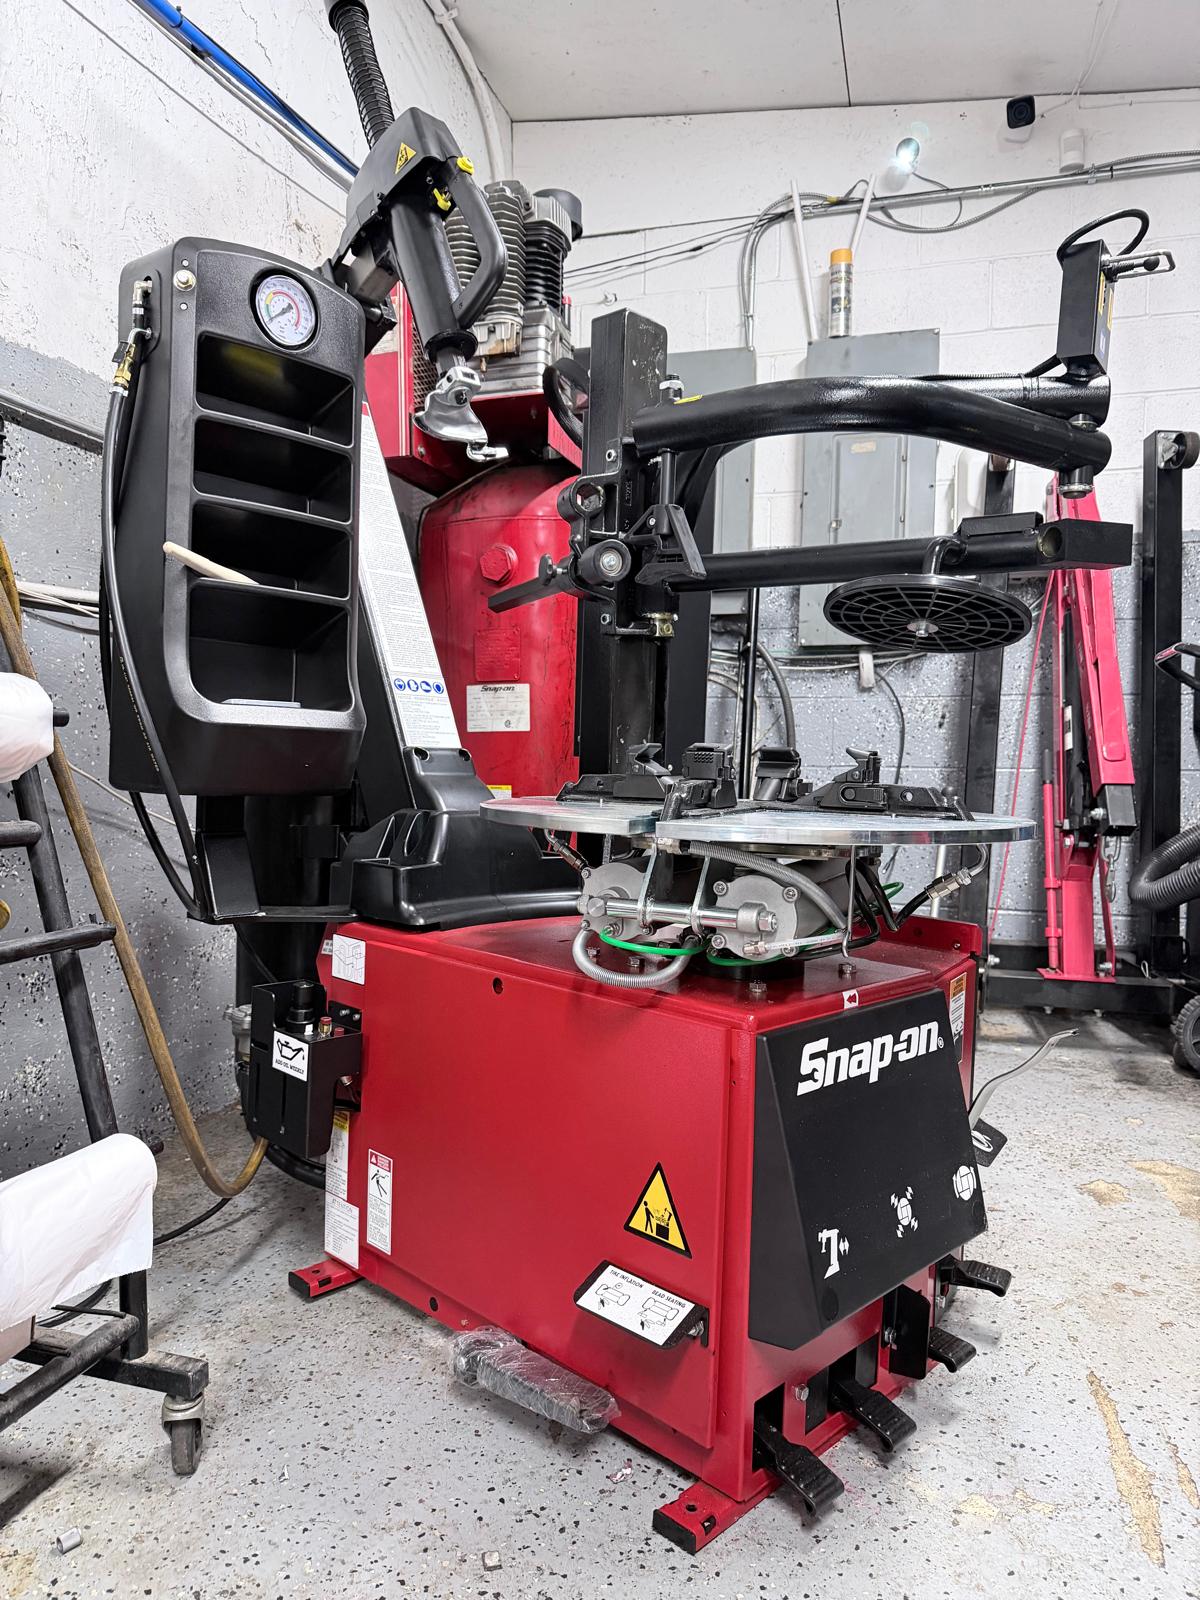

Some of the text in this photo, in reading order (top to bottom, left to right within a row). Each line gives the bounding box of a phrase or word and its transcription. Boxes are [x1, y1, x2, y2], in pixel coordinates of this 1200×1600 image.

[481, 685, 515, 693] Snap-on
[290, 1064, 305, 1075] WEEKLY
[610, 1269, 644, 1288] TIRE INFLATION
[652, 1289, 686, 1308] BEAD SEATING
